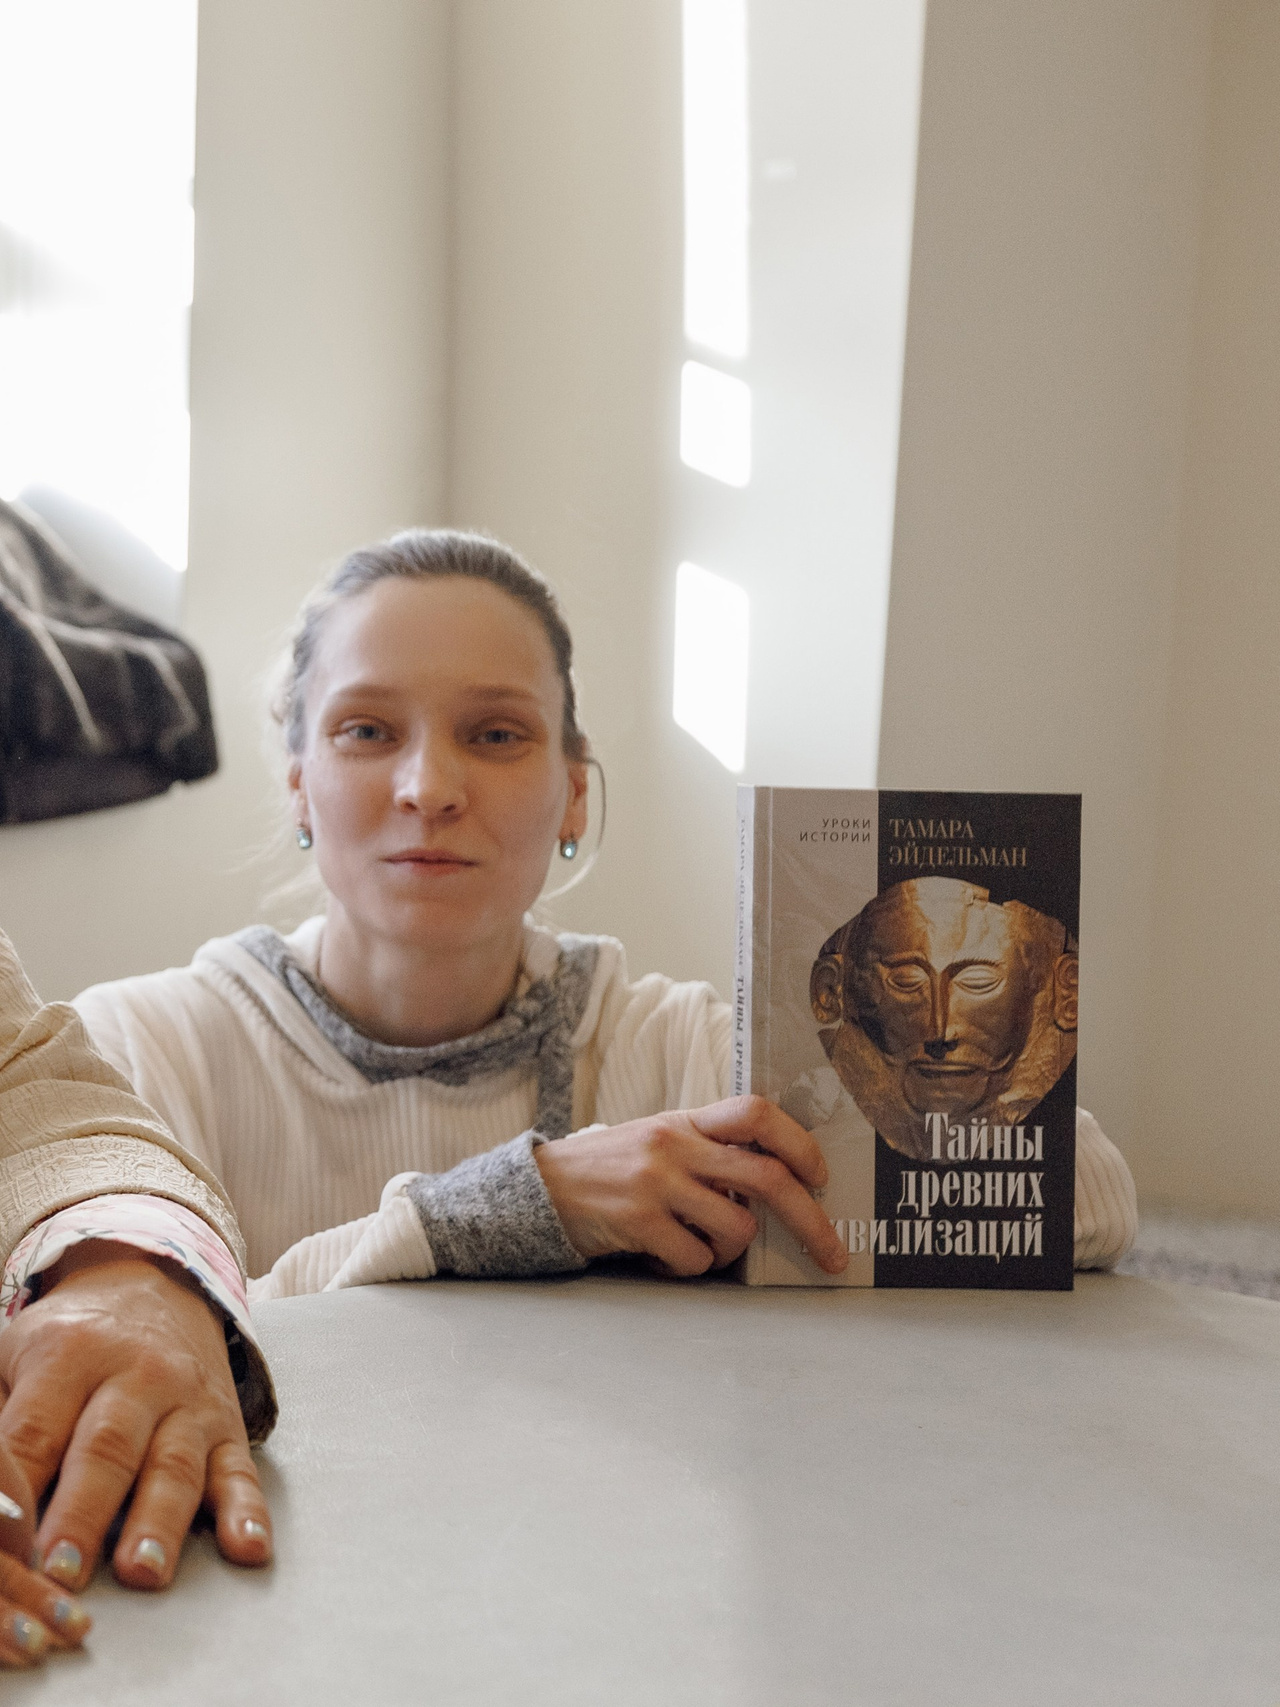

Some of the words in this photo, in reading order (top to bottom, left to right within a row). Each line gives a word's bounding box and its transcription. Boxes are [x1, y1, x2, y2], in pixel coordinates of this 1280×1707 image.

[799, 831, 871, 843] ИСТОРИИ
[821, 818, 871, 829] УРОКИ
[889, 818, 975, 840] ТАМАРА
[888, 841, 1028, 869] ЭЙДЕЛЬМАН
[924, 1112, 1045, 1162] Тайны
[896, 1169, 1046, 1219] древних
[801, 1212, 1044, 1265] вилизаций
